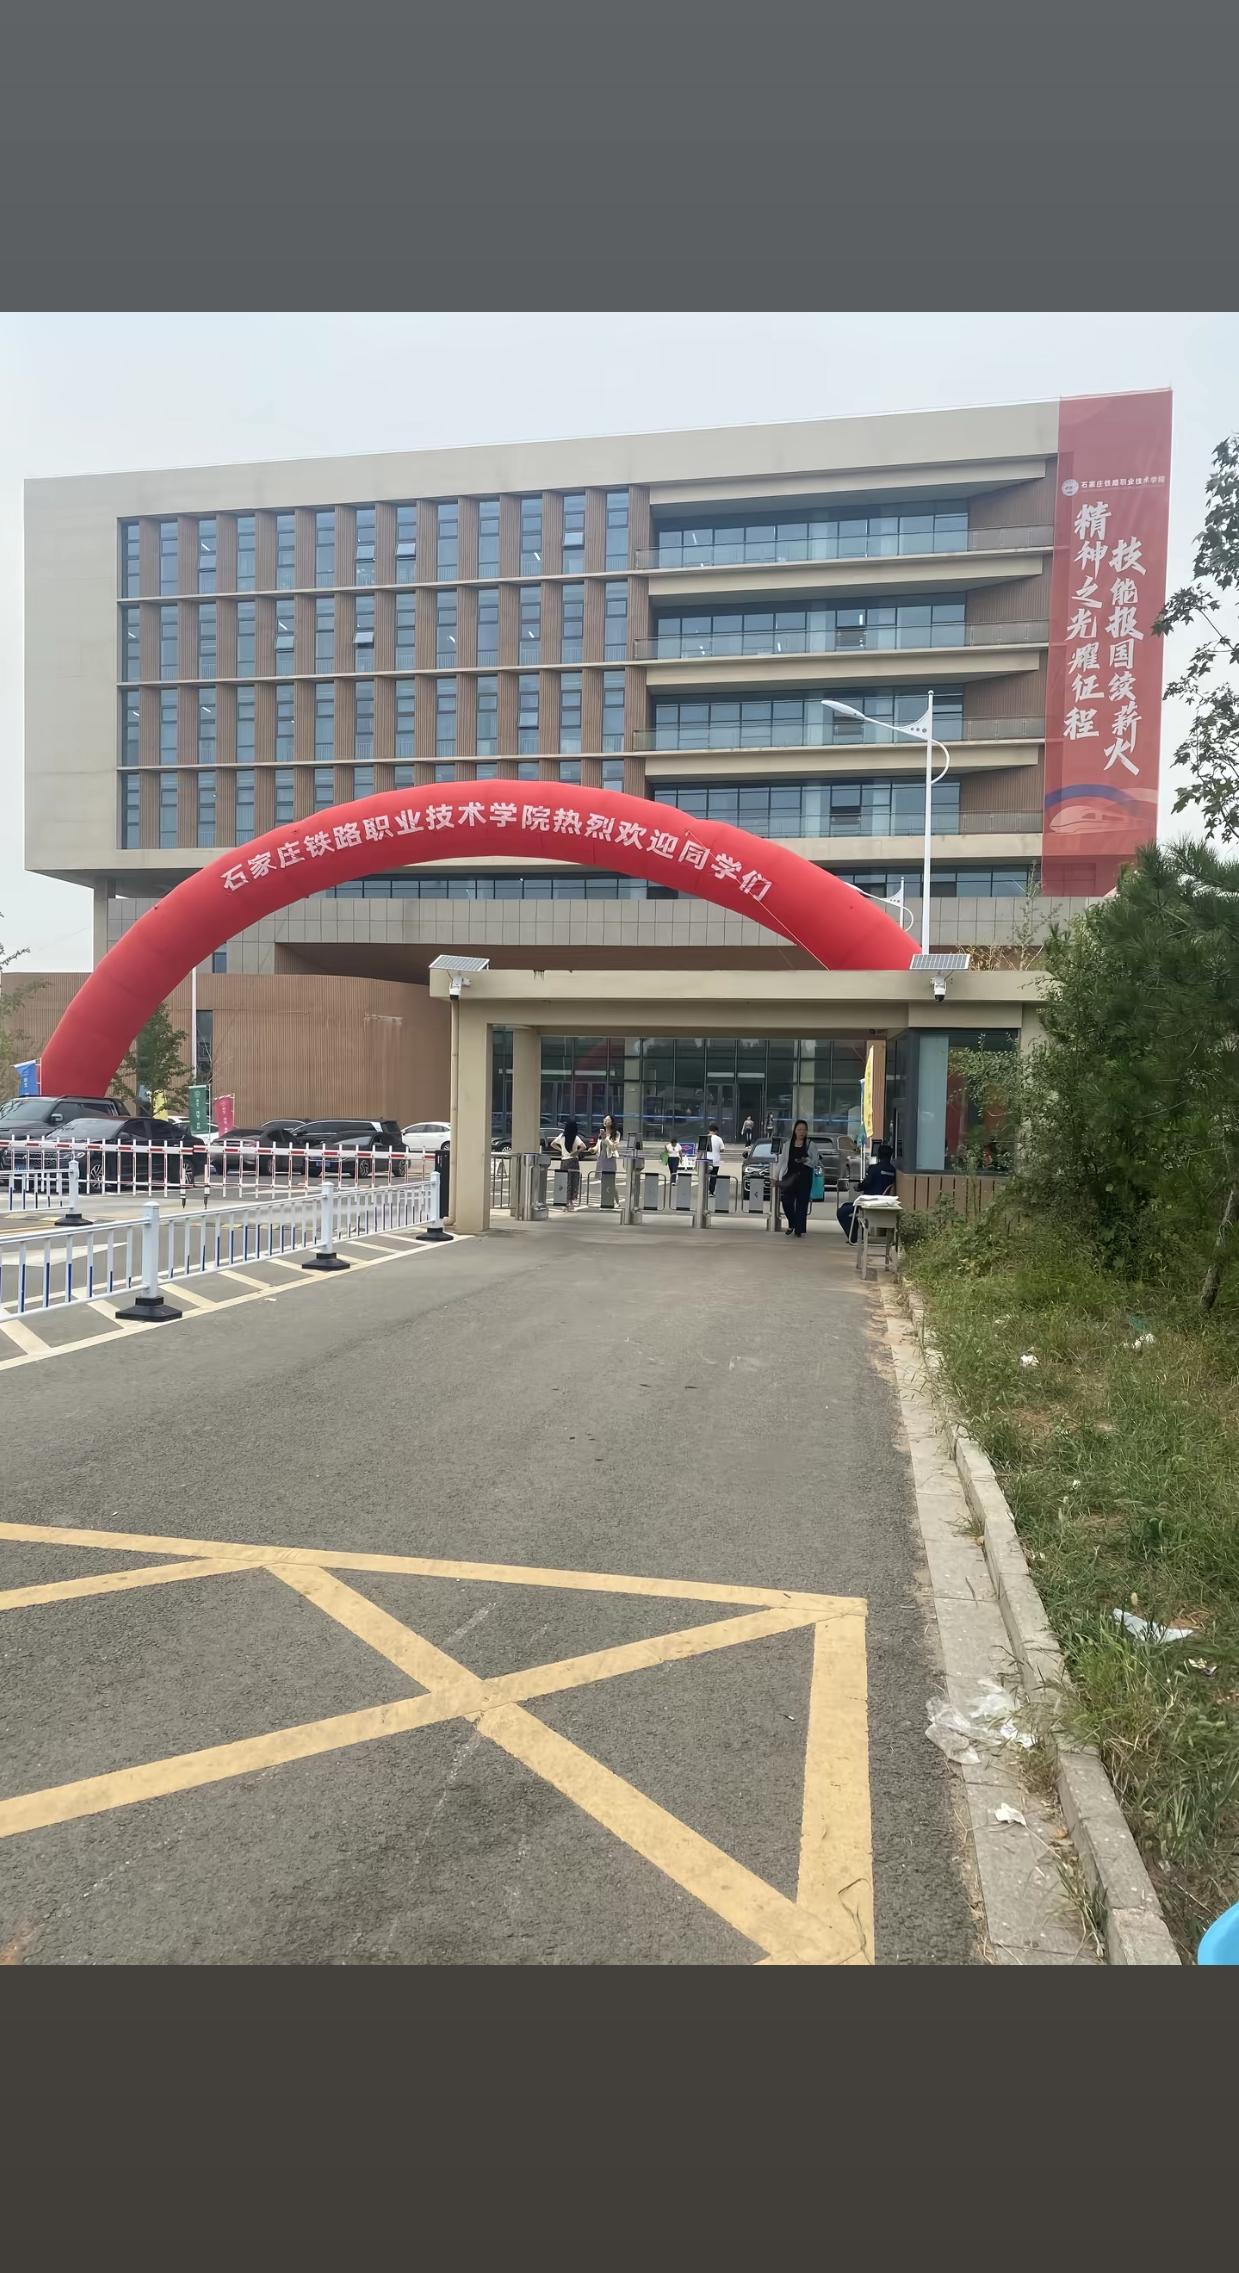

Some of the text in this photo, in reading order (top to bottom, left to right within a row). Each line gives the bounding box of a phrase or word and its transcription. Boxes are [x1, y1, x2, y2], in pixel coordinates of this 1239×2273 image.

[1064, 501, 1112, 741] 精神之光耀征程
[1103, 536, 1147, 776] 技能报国续薪火
[219, 801, 773, 902] 石家庄铁路职业技术学院热烈欢迎同学们
